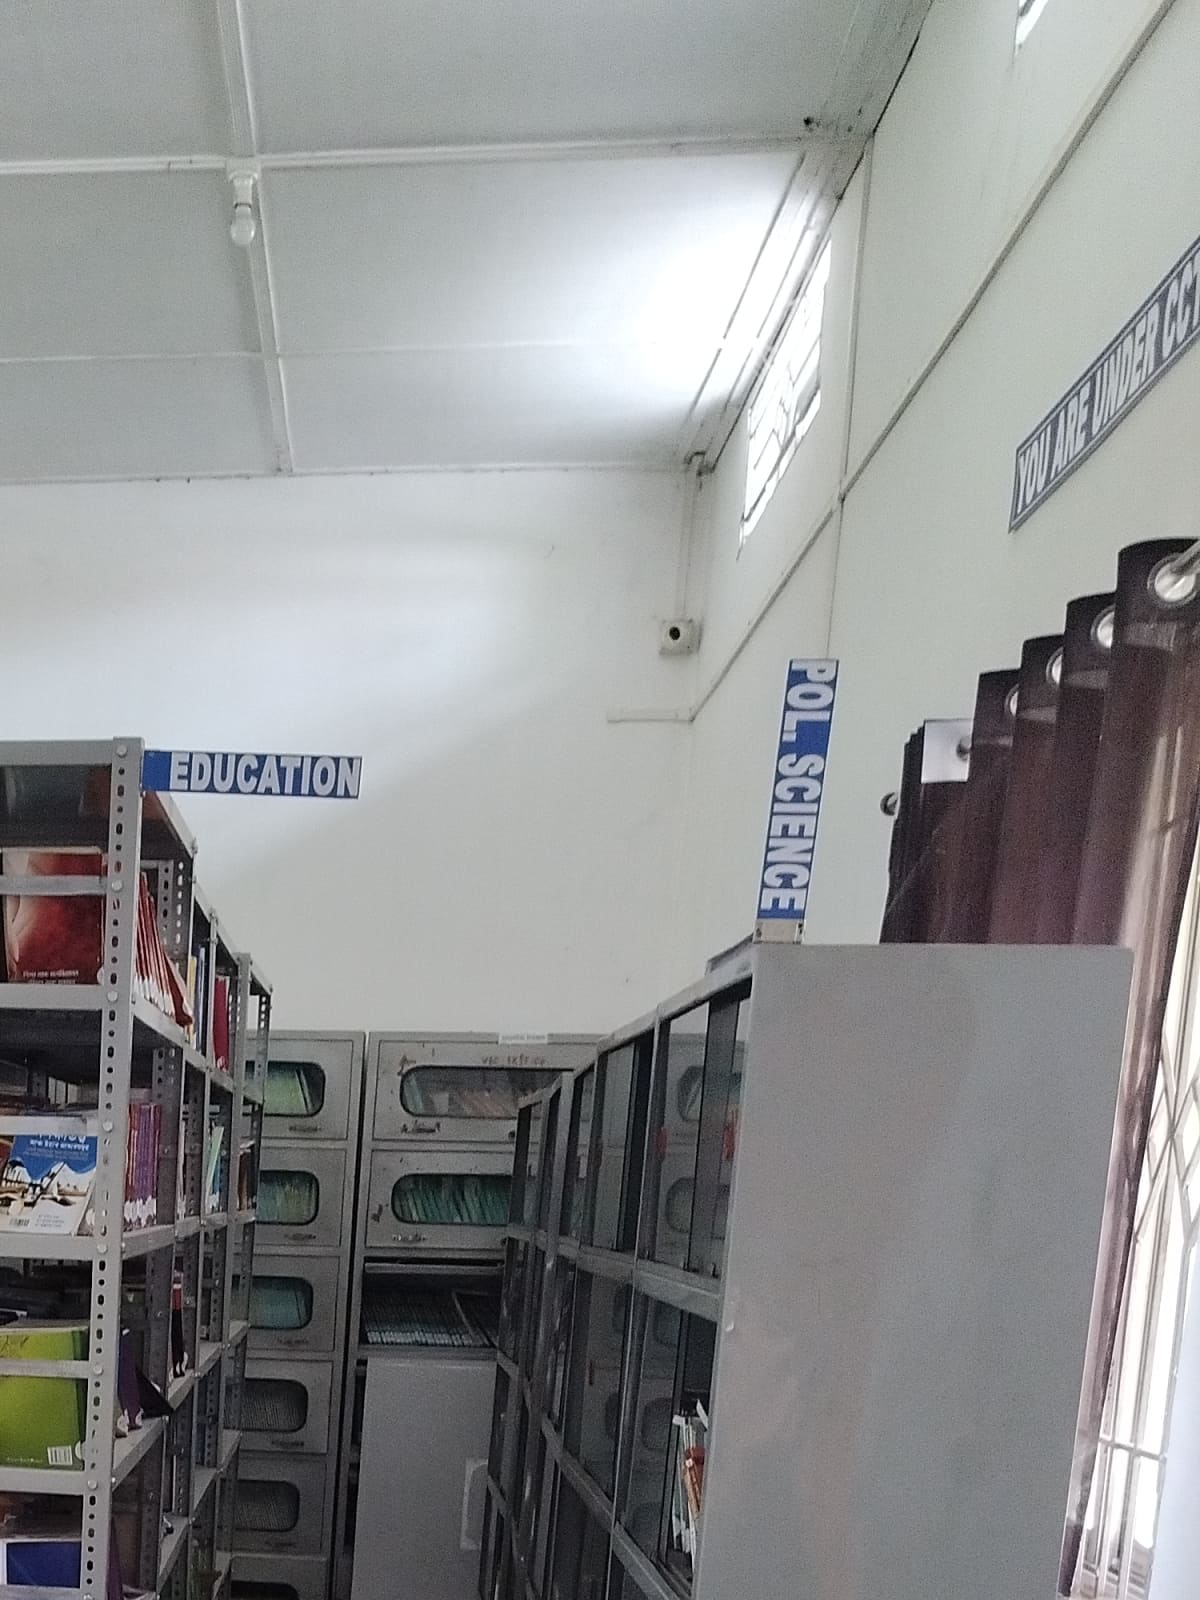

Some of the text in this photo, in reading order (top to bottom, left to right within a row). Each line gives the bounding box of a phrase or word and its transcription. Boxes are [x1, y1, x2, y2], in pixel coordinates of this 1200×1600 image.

[1016, 423, 1052, 515] YOU
[1050, 380, 1092, 480] ARE
[1091, 302, 1160, 437] UNDER
[169, 751, 361, 797] EDUCATION
[759, 659, 837, 911] POL. SCIENCE
